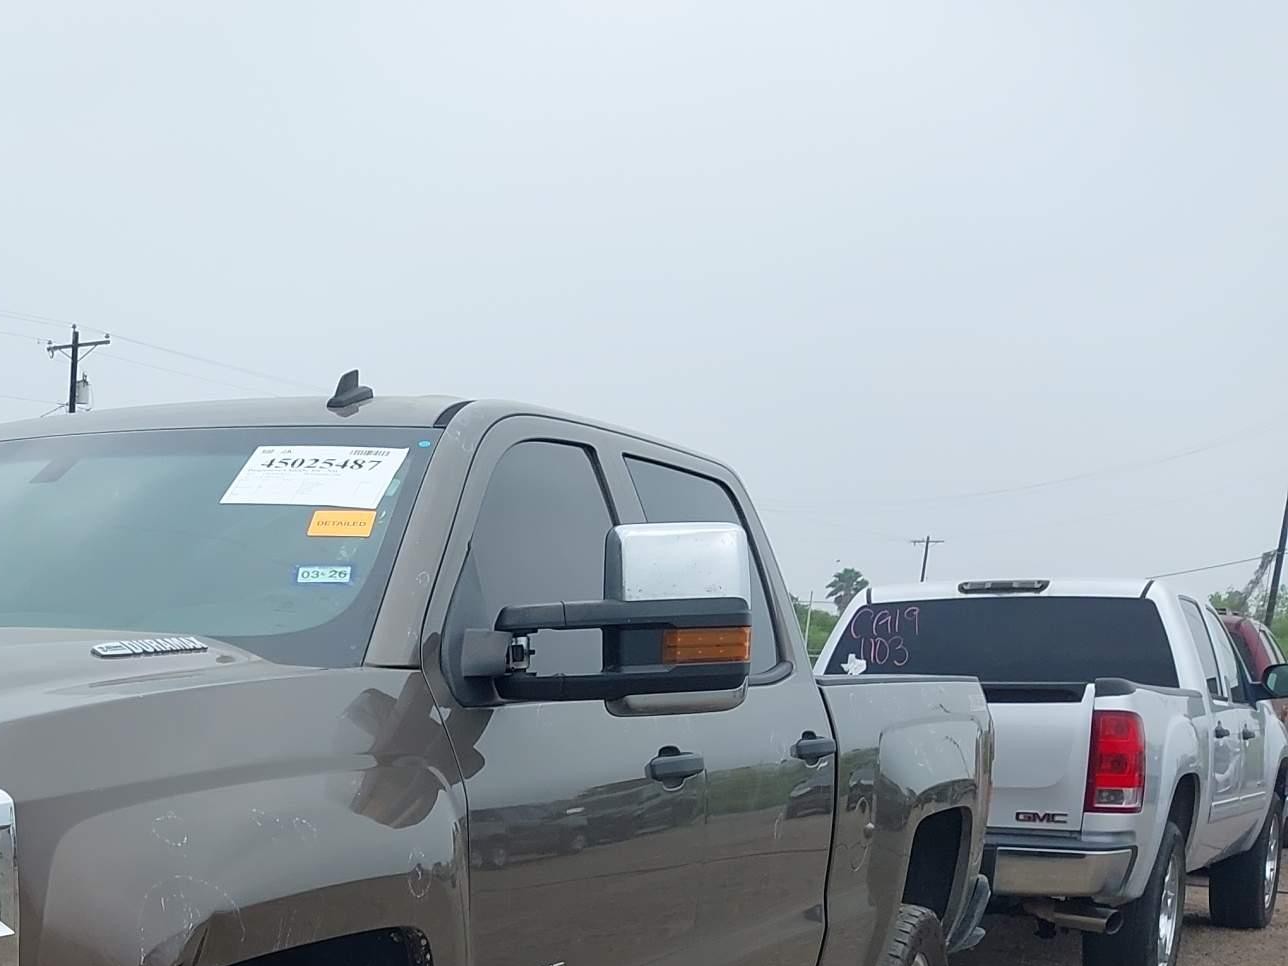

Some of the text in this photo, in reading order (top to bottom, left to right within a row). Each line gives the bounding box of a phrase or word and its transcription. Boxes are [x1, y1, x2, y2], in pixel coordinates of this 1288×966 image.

[260, 457, 383, 472] 45025487
[316, 520, 367, 528] DETAILED
[1015, 810, 1069, 824] GMC
